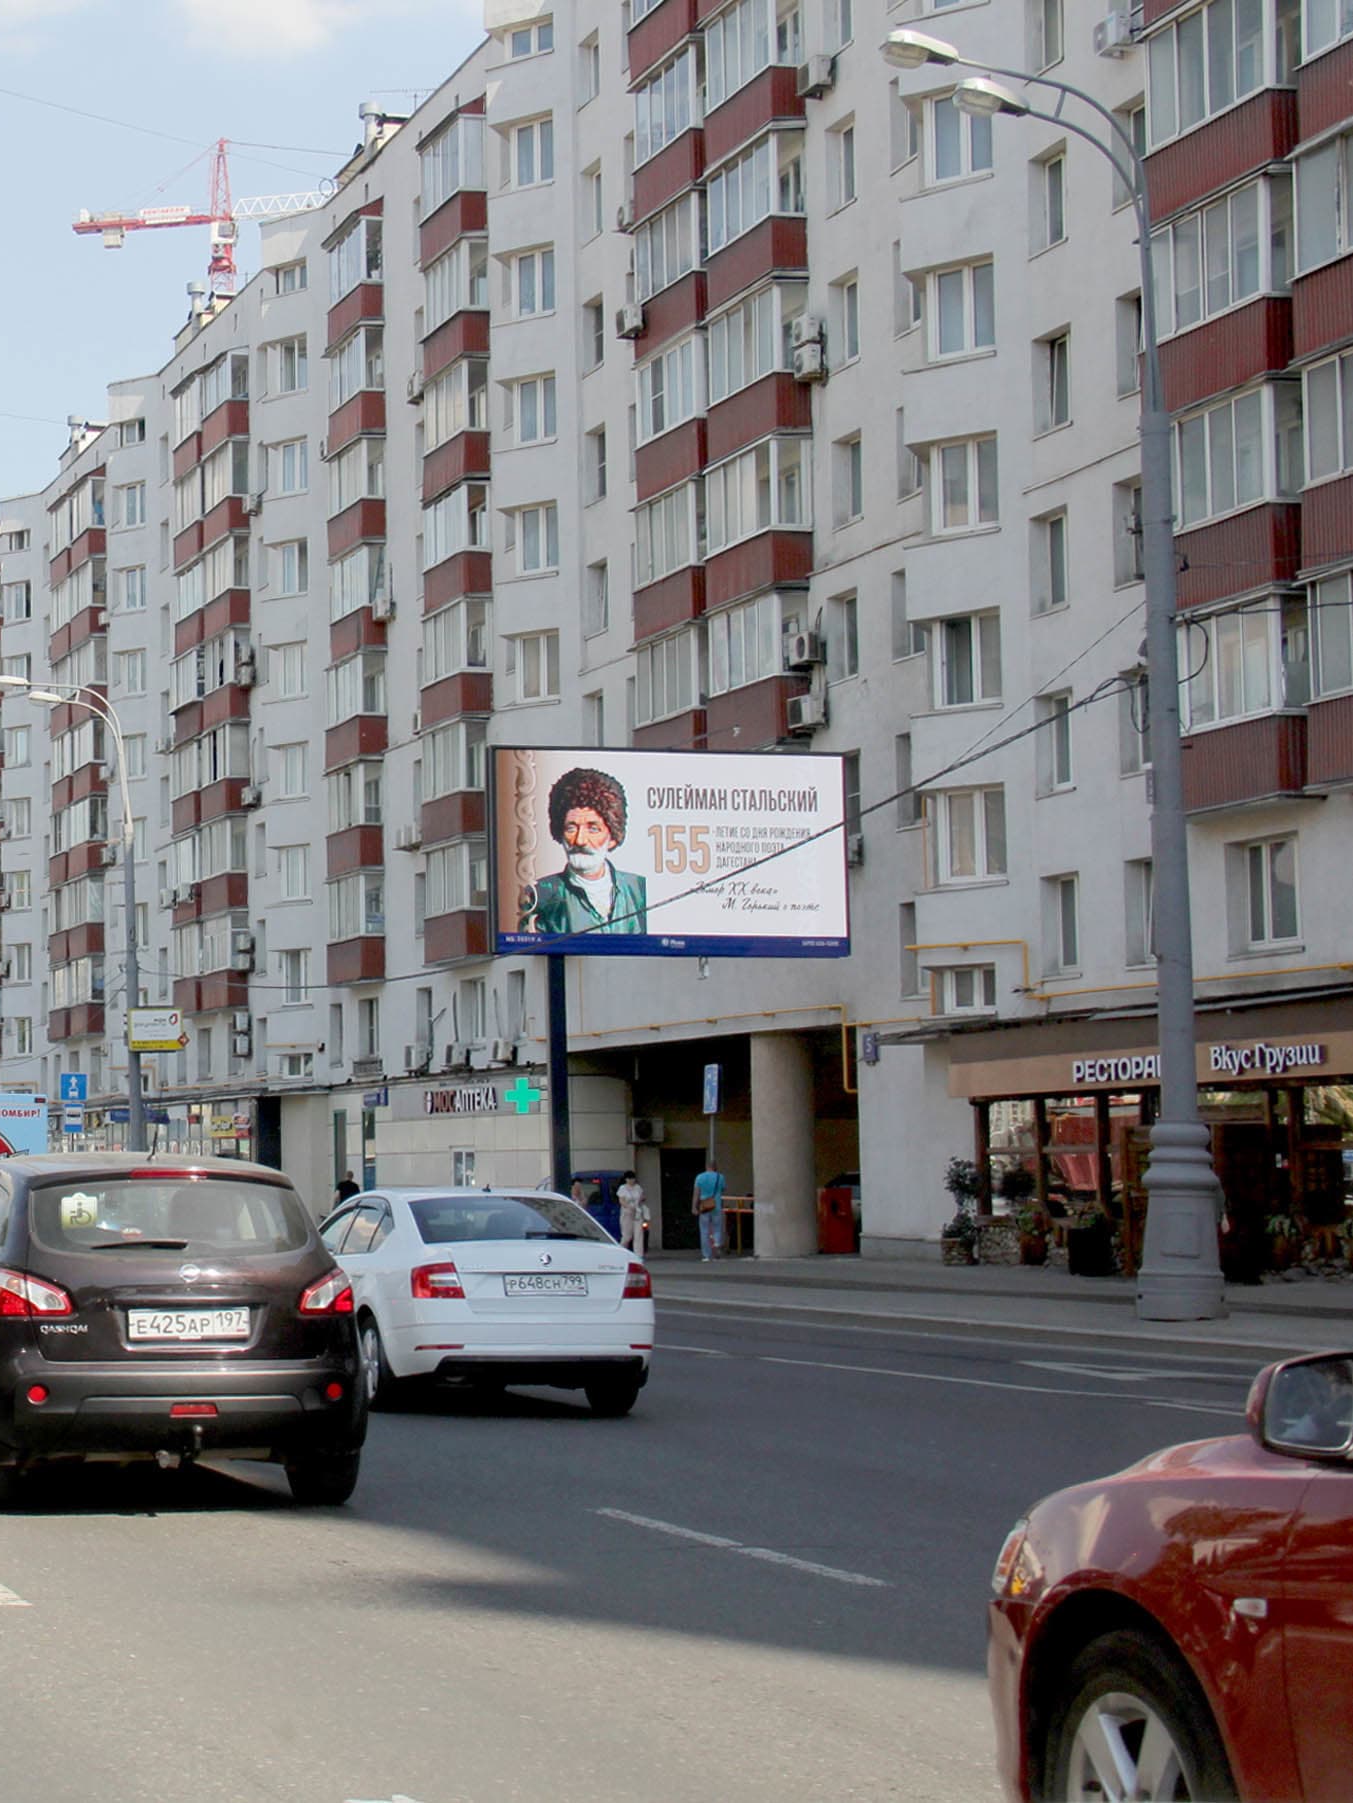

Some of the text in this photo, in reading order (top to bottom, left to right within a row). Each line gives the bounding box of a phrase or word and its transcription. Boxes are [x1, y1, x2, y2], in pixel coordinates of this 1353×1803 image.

[648, 784, 818, 812] СУЛЕЙМАН СТАЛЬСКИЙ
[740, 826, 750, 838] СО
[752, 827, 767, 839] ДНЯ
[769, 827, 810, 839] РОЖДЕНИЯ
[648, 824, 711, 874] 155
[716, 841, 784, 854] НАРОДНОГО ПОЭТА
[742, 898, 779, 912] Горький
[1210, 1045, 1250, 1075] Вкус
[1255, 1043, 1321, 1073] Грузии
[434, 1087, 498, 1113] МОСАПТЕКА
[136, 1311, 243, 1335] Е425АР 197
